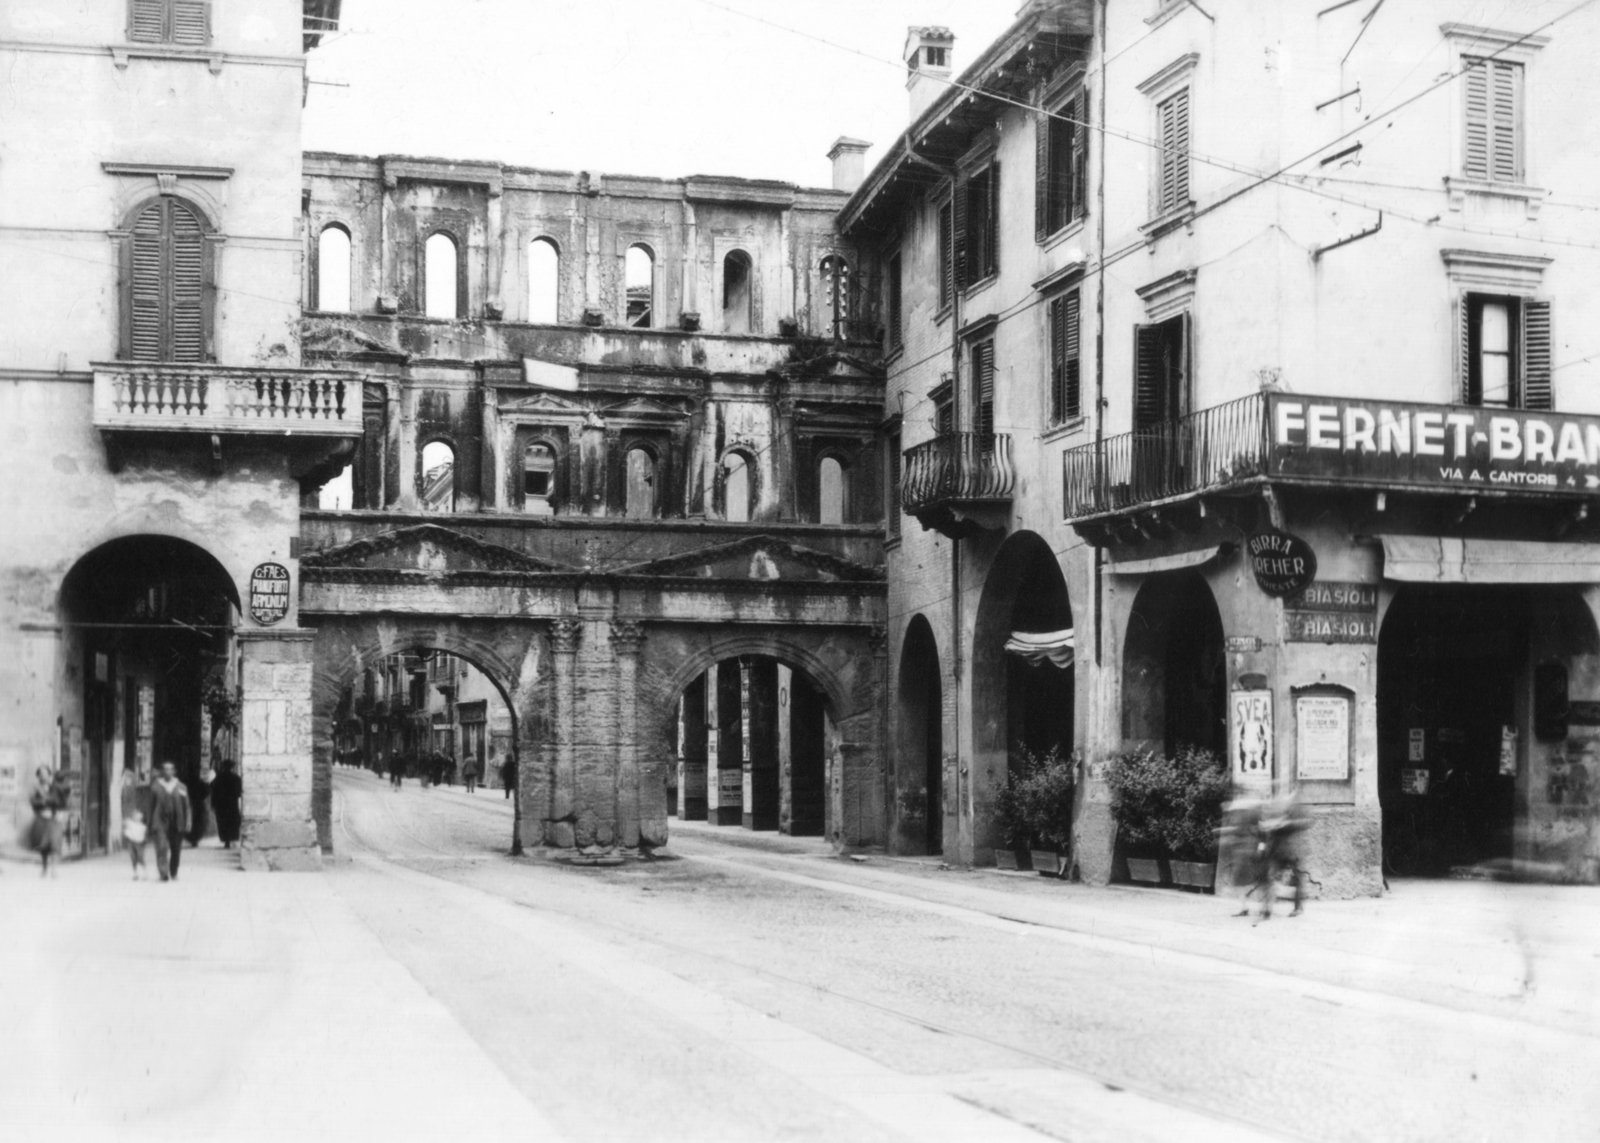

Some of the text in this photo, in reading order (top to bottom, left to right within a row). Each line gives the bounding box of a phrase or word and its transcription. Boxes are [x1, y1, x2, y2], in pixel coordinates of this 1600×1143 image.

[1439, 467, 1464, 480] VIA
[1469, 469, 1484, 481] A.
[1489, 470, 1558, 486] CANTORE
[1250, 534, 1292, 555] BIRRA
[1305, 588, 1376, 606] BIASIOLI
[1304, 620, 1375, 637] BIASIOLI
[1236, 698, 1270, 727] SVEA
